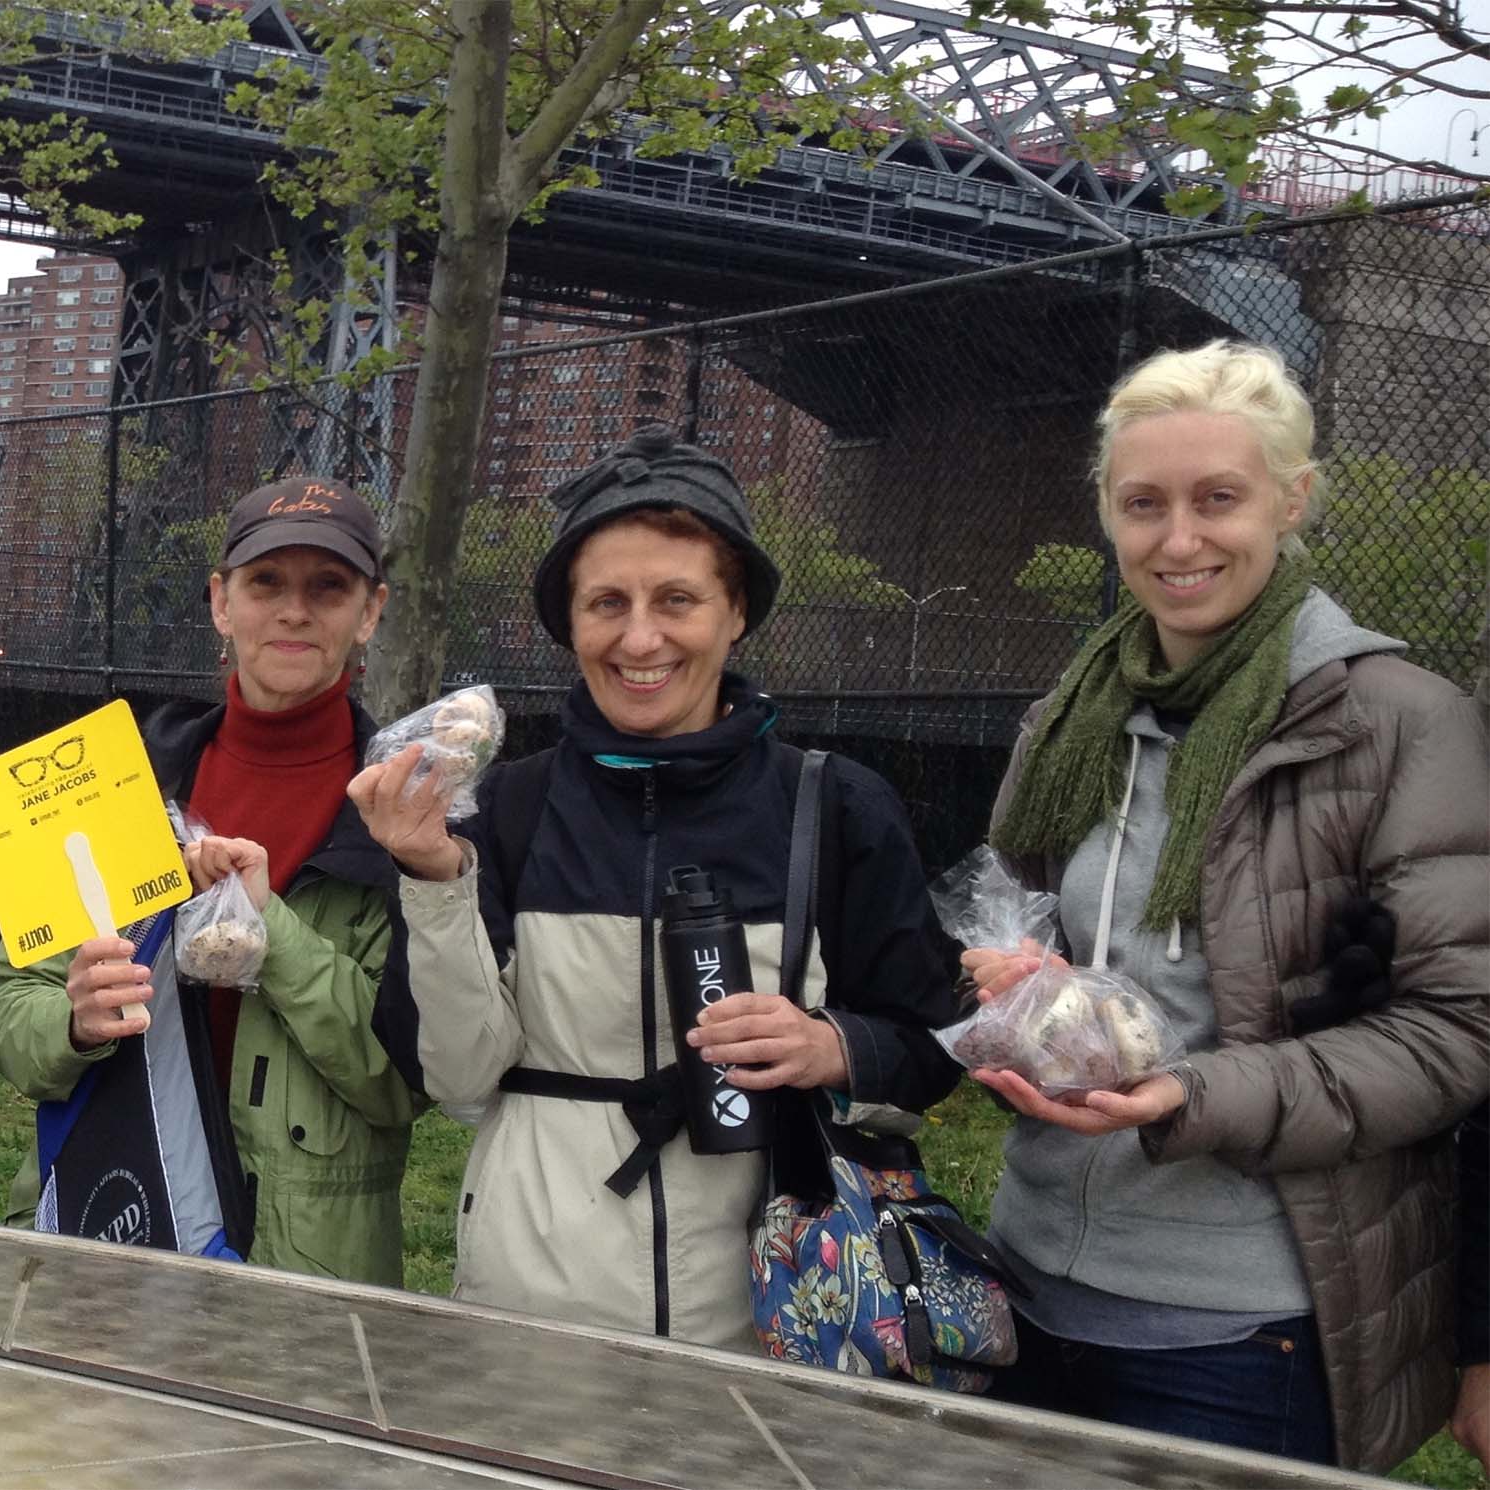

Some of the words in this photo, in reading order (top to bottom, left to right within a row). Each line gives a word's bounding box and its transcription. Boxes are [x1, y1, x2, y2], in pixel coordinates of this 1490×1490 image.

[304, 484, 343, 500] The
[21, 789, 51, 811] JANE
[53, 769, 97, 797] JACOBS
[132, 870, 182, 906] JJ100.ORG
[18, 923, 54, 953] #JJ100
[694, 946, 726, 1006] ONE
[94, 1202, 140, 1243] YPD
